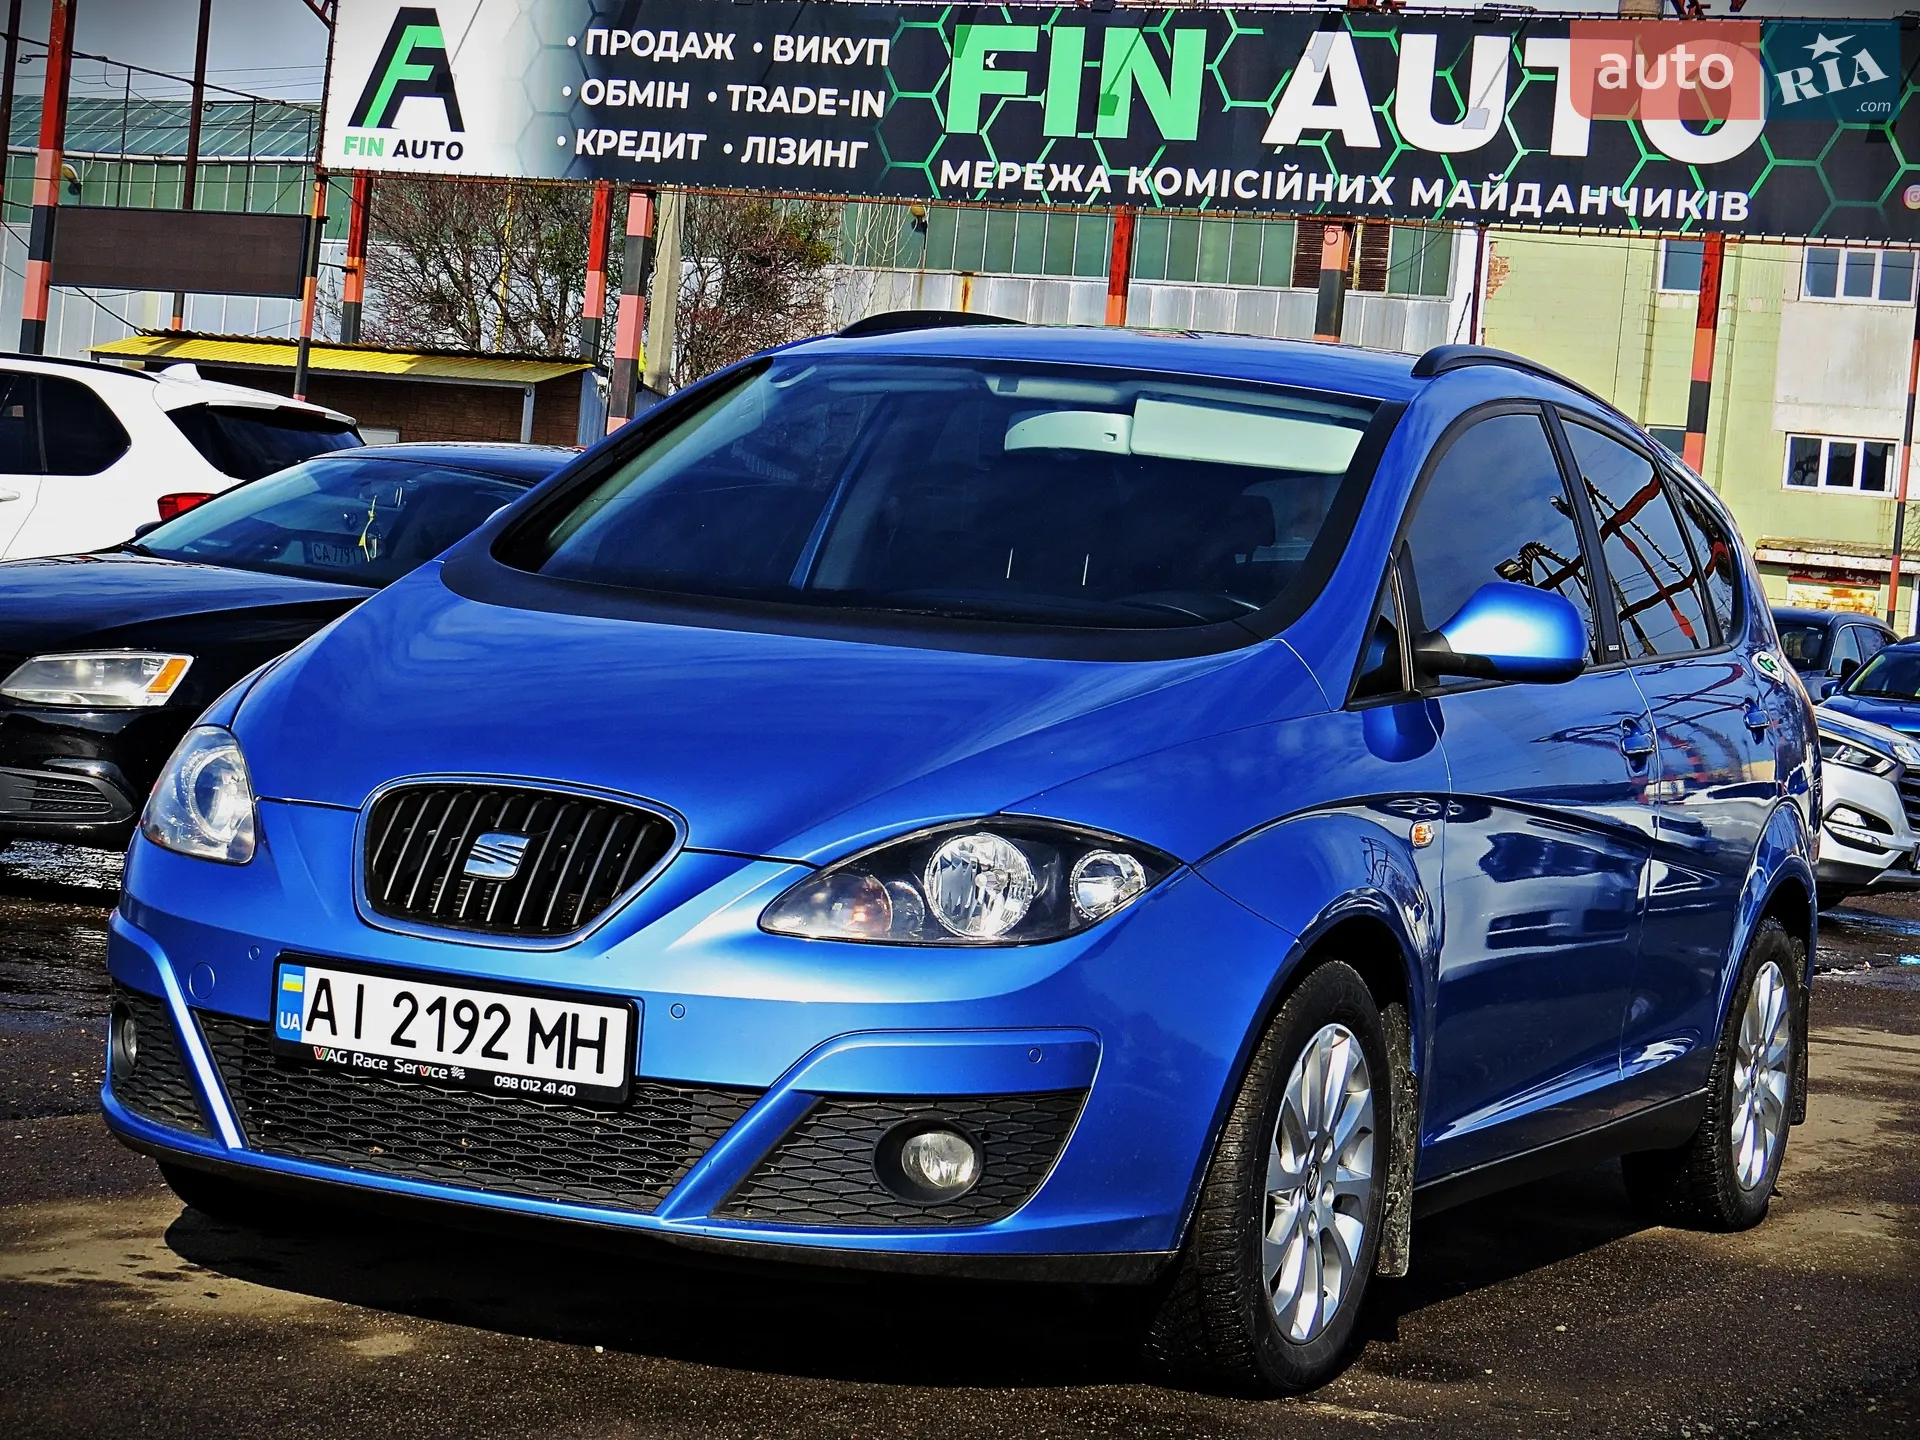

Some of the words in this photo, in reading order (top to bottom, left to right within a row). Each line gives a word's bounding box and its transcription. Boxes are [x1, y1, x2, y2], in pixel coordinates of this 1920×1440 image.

[585, 28, 735, 63] ПРОДАЖ
[772, 34, 890, 67] ВИКУП
[580, 78, 690, 109] ОБМІН
[727, 84, 885, 118] TRADE-IN
[945, 25, 1207, 141] FIN
[1262, 31, 1769, 164] AUTO
[344, 136, 384, 156] FIN
[392, 139, 464, 161] AUTO
[574, 128, 707, 162] КРЕДИТ
[740, 135, 868, 168] ЛІЗИНГ
[940, 160, 1110, 193] МЕРЕЖА
[1127, 163, 1396, 205] КОМІСІЙНИХ
[1410, 174, 1750, 222] МАЙДАНЧИКІВ
[279, 1011, 301, 1030] UA
[390, 991, 512, 1061] 2192
[313, 1045, 348, 1065] VAG
[352, 1052, 388, 1071] Race
[494, 1075, 519, 1089] 098
[520, 1079, 541, 1092] 012
[542, 1082, 556, 1094] 41
[558, 1084, 576, 1096] 40
